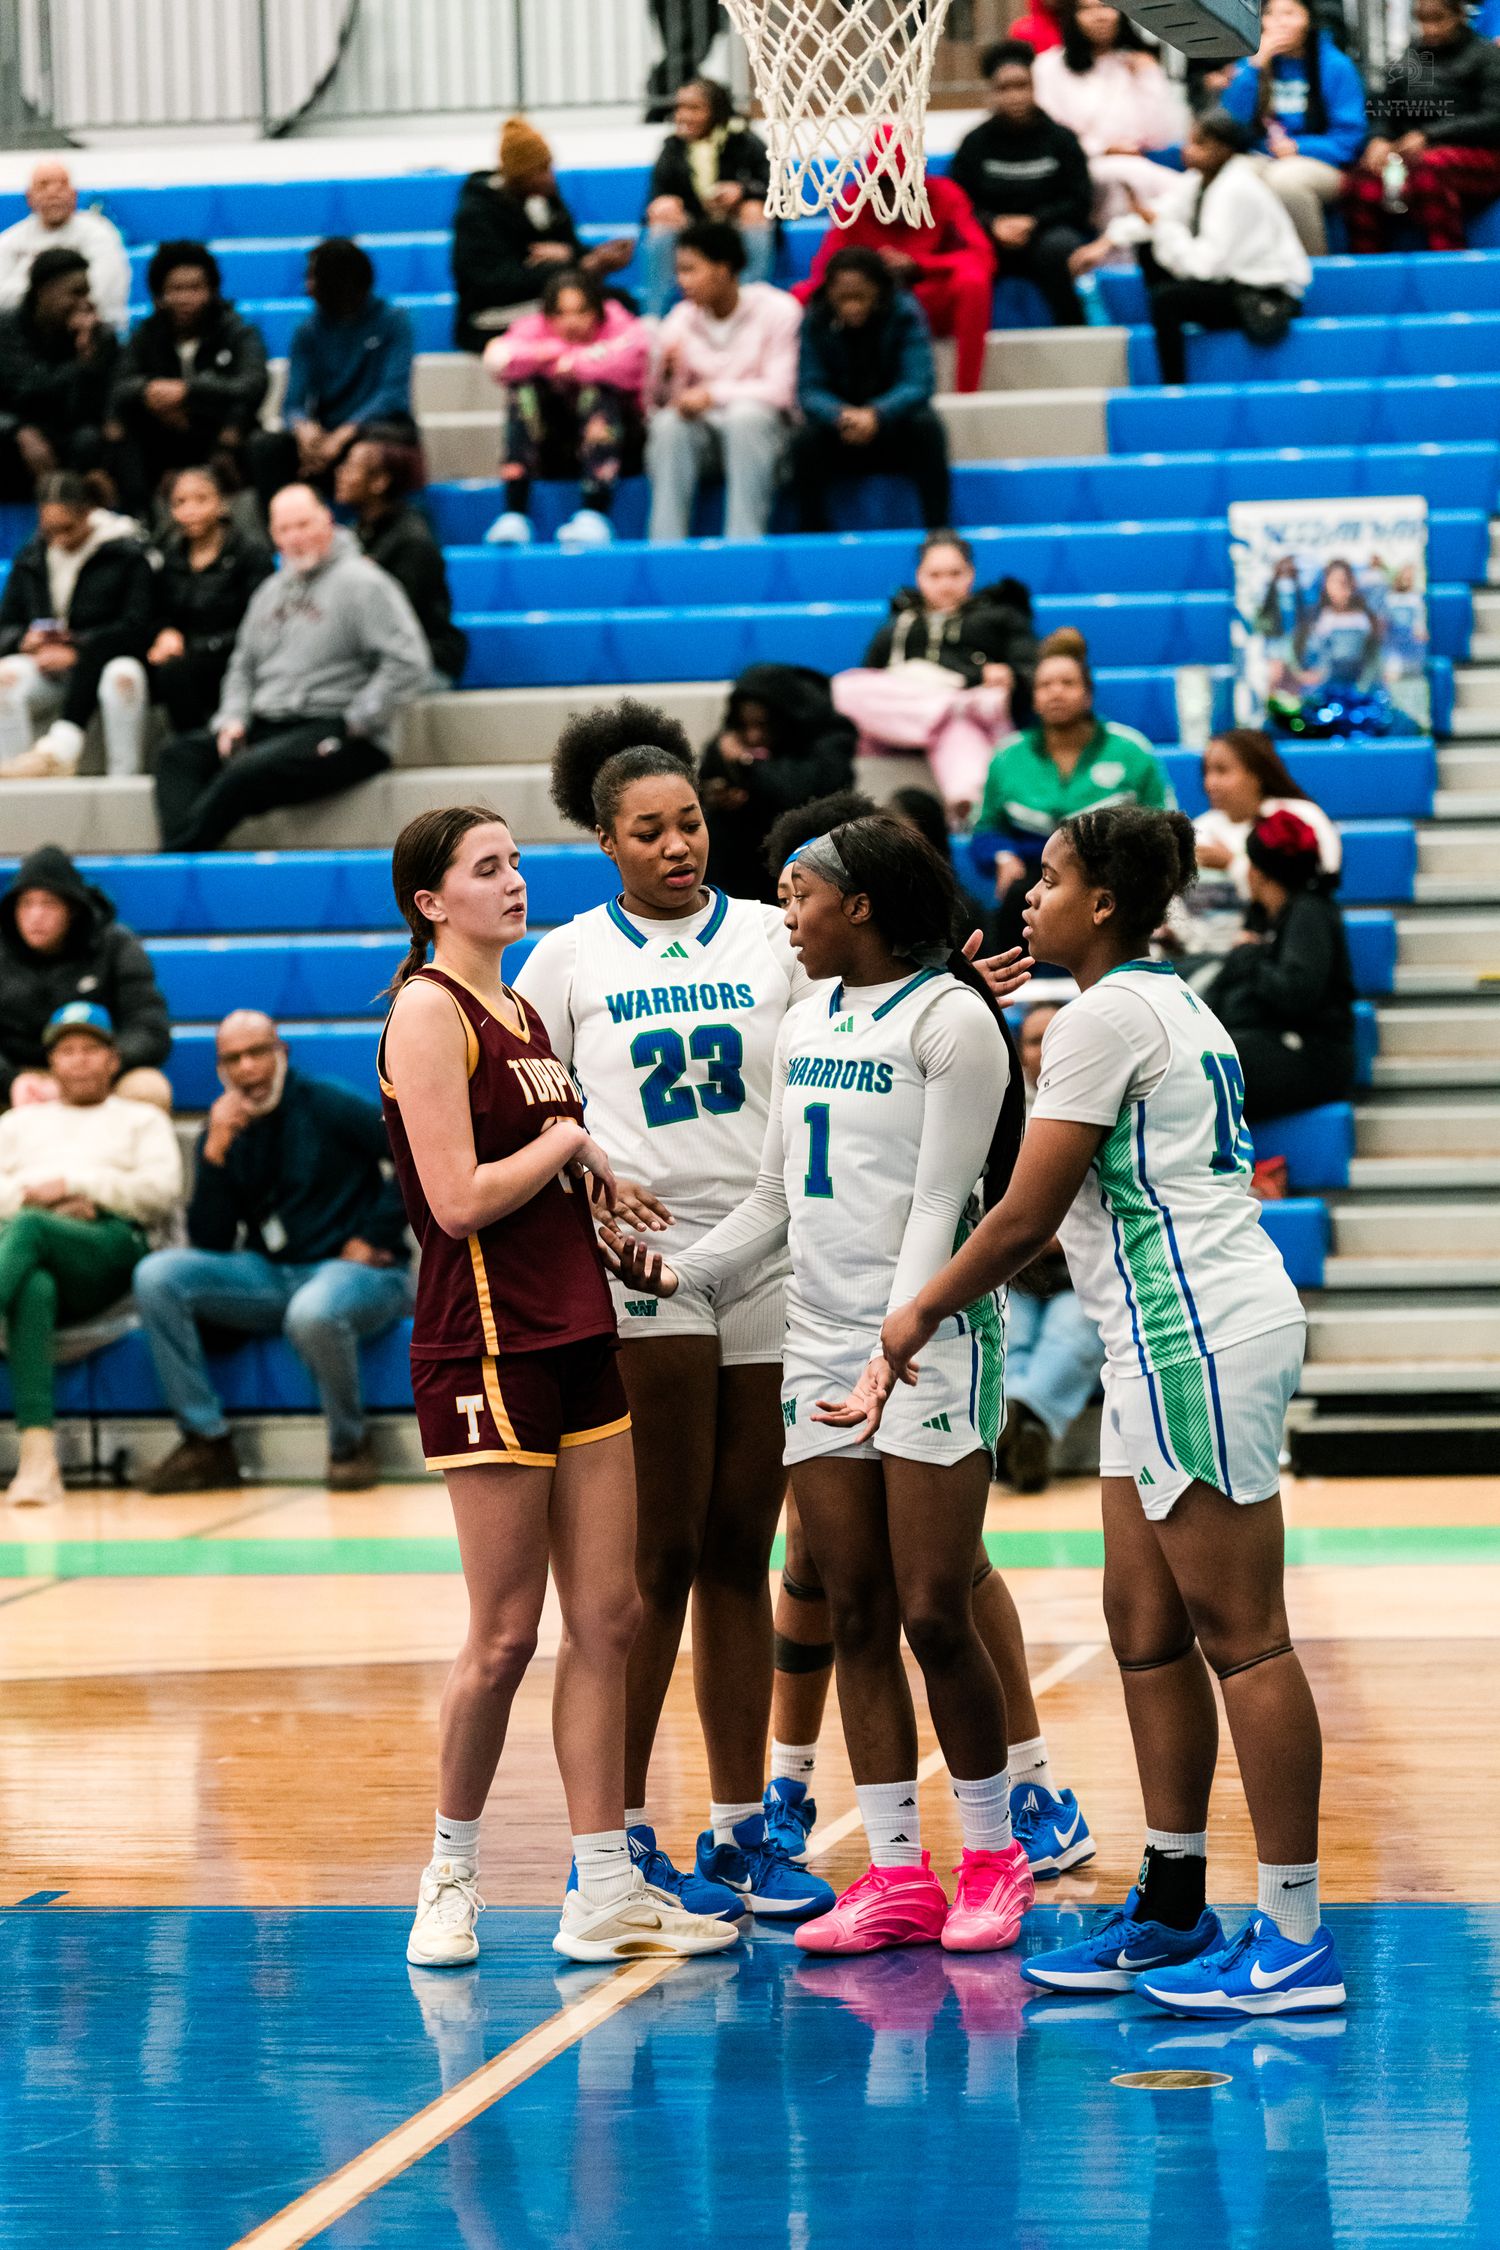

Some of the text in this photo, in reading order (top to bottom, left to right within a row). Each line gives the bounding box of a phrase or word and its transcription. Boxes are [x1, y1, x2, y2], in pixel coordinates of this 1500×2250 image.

[605, 982, 755, 1024] WARRIORS
[506, 1057, 583, 1106] TURPI
[630, 1023, 746, 1129] 23
[786, 1056, 894, 1094] WARRIORS
[803, 1102, 834, 1199] 1
[455, 1393, 485, 1445] T
